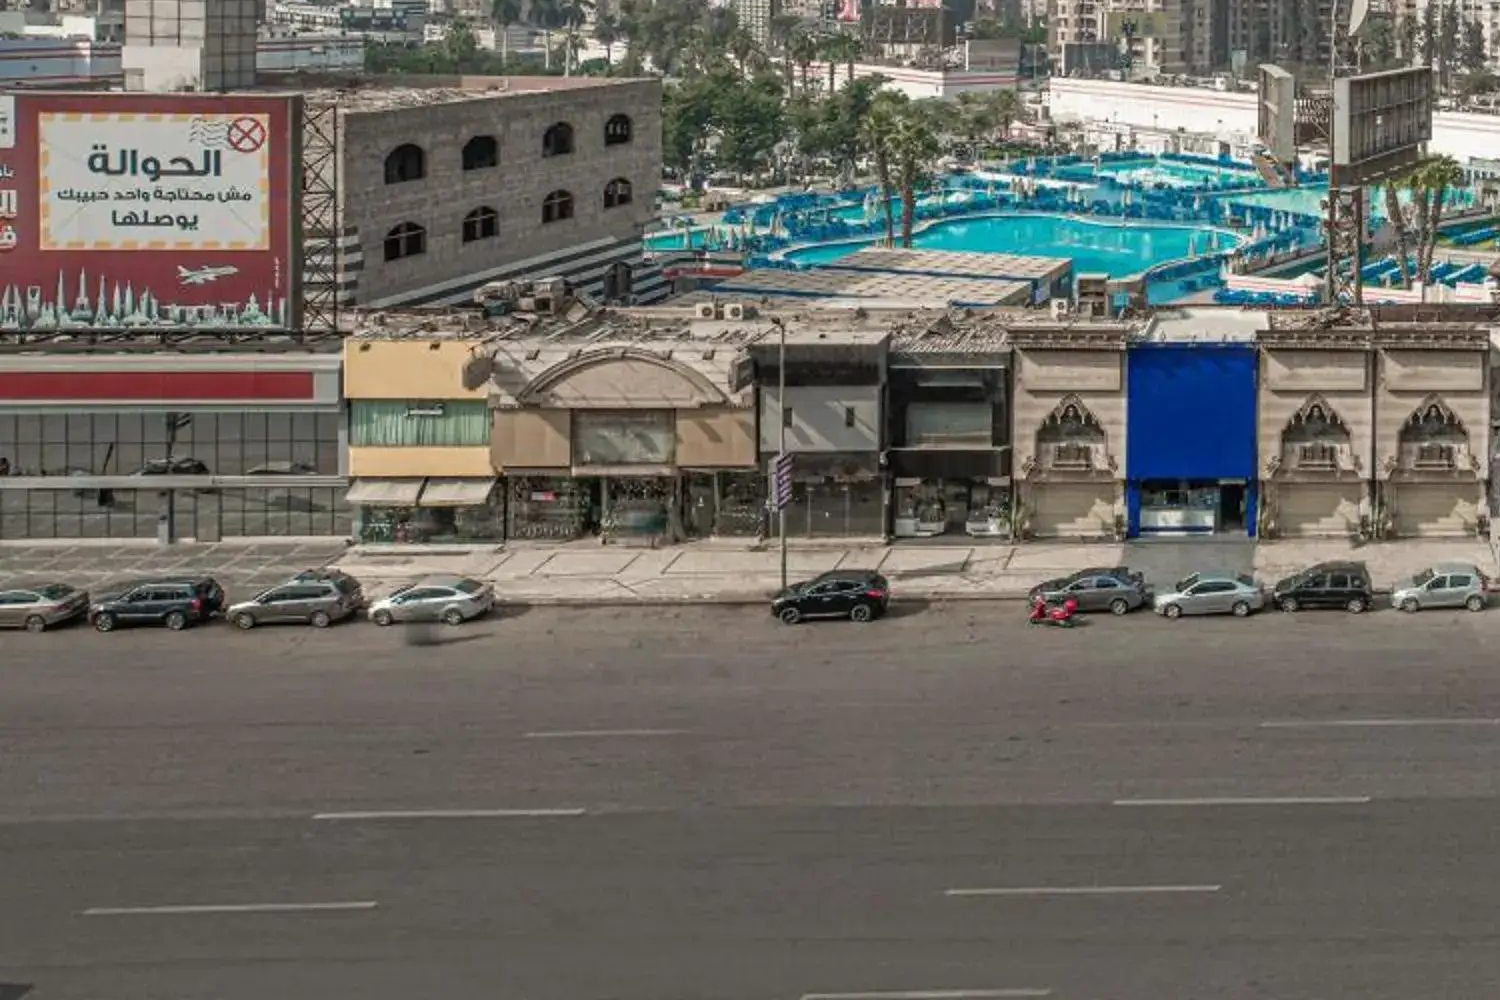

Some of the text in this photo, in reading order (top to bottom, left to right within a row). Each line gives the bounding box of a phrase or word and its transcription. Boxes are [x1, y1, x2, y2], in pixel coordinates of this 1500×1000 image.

[88, 144, 221, 181] الحوالة
[57, 187, 252, 203] مش محتاجة واحد حبيبك
[112, 210, 199, 230] يوصلها
